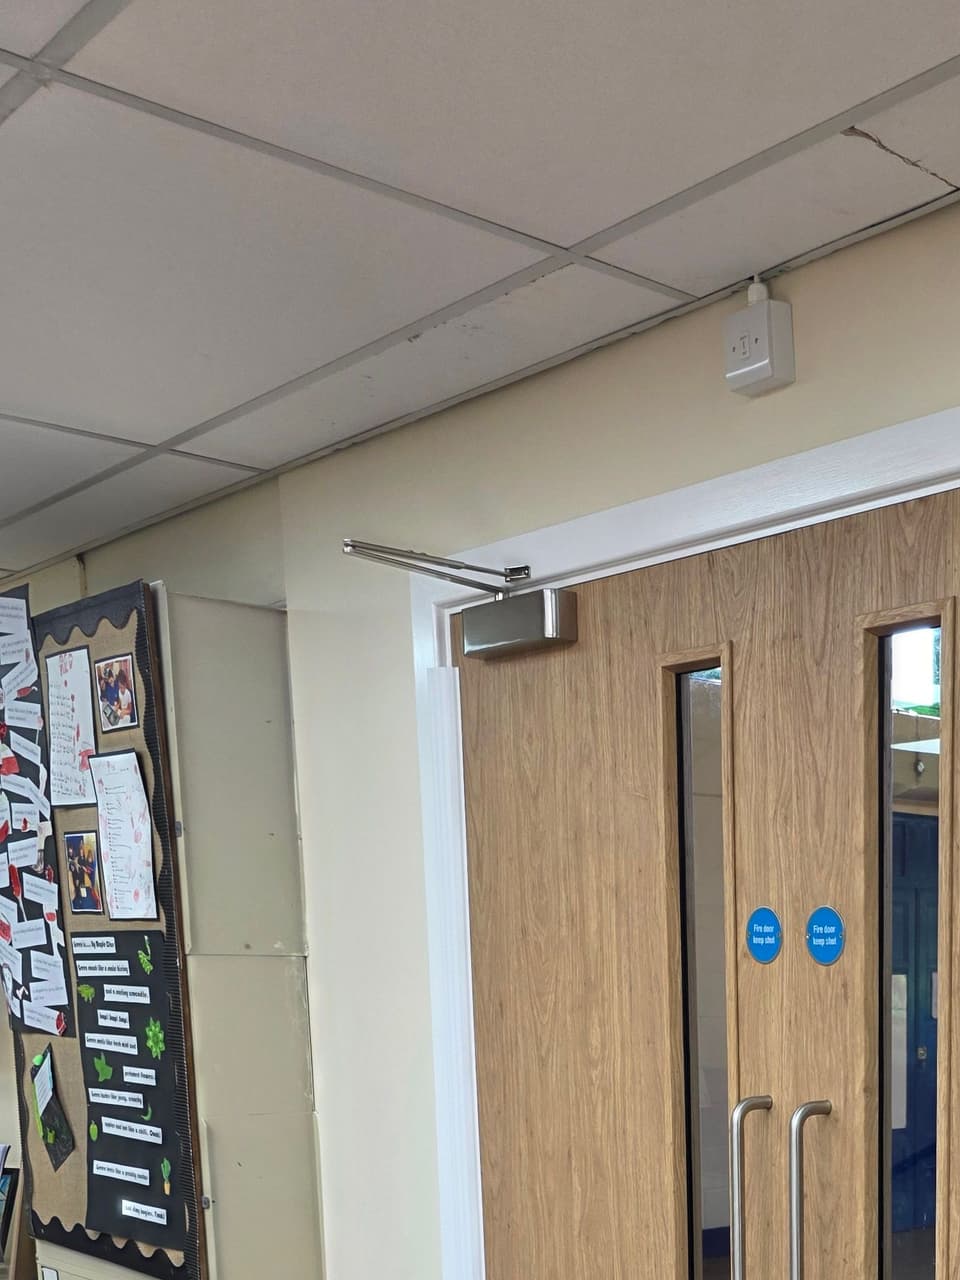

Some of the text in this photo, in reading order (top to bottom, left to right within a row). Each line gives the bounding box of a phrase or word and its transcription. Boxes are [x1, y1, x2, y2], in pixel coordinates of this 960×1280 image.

[753, 924, 775, 933] Fire door
[813, 925, 836, 934] Fire door
